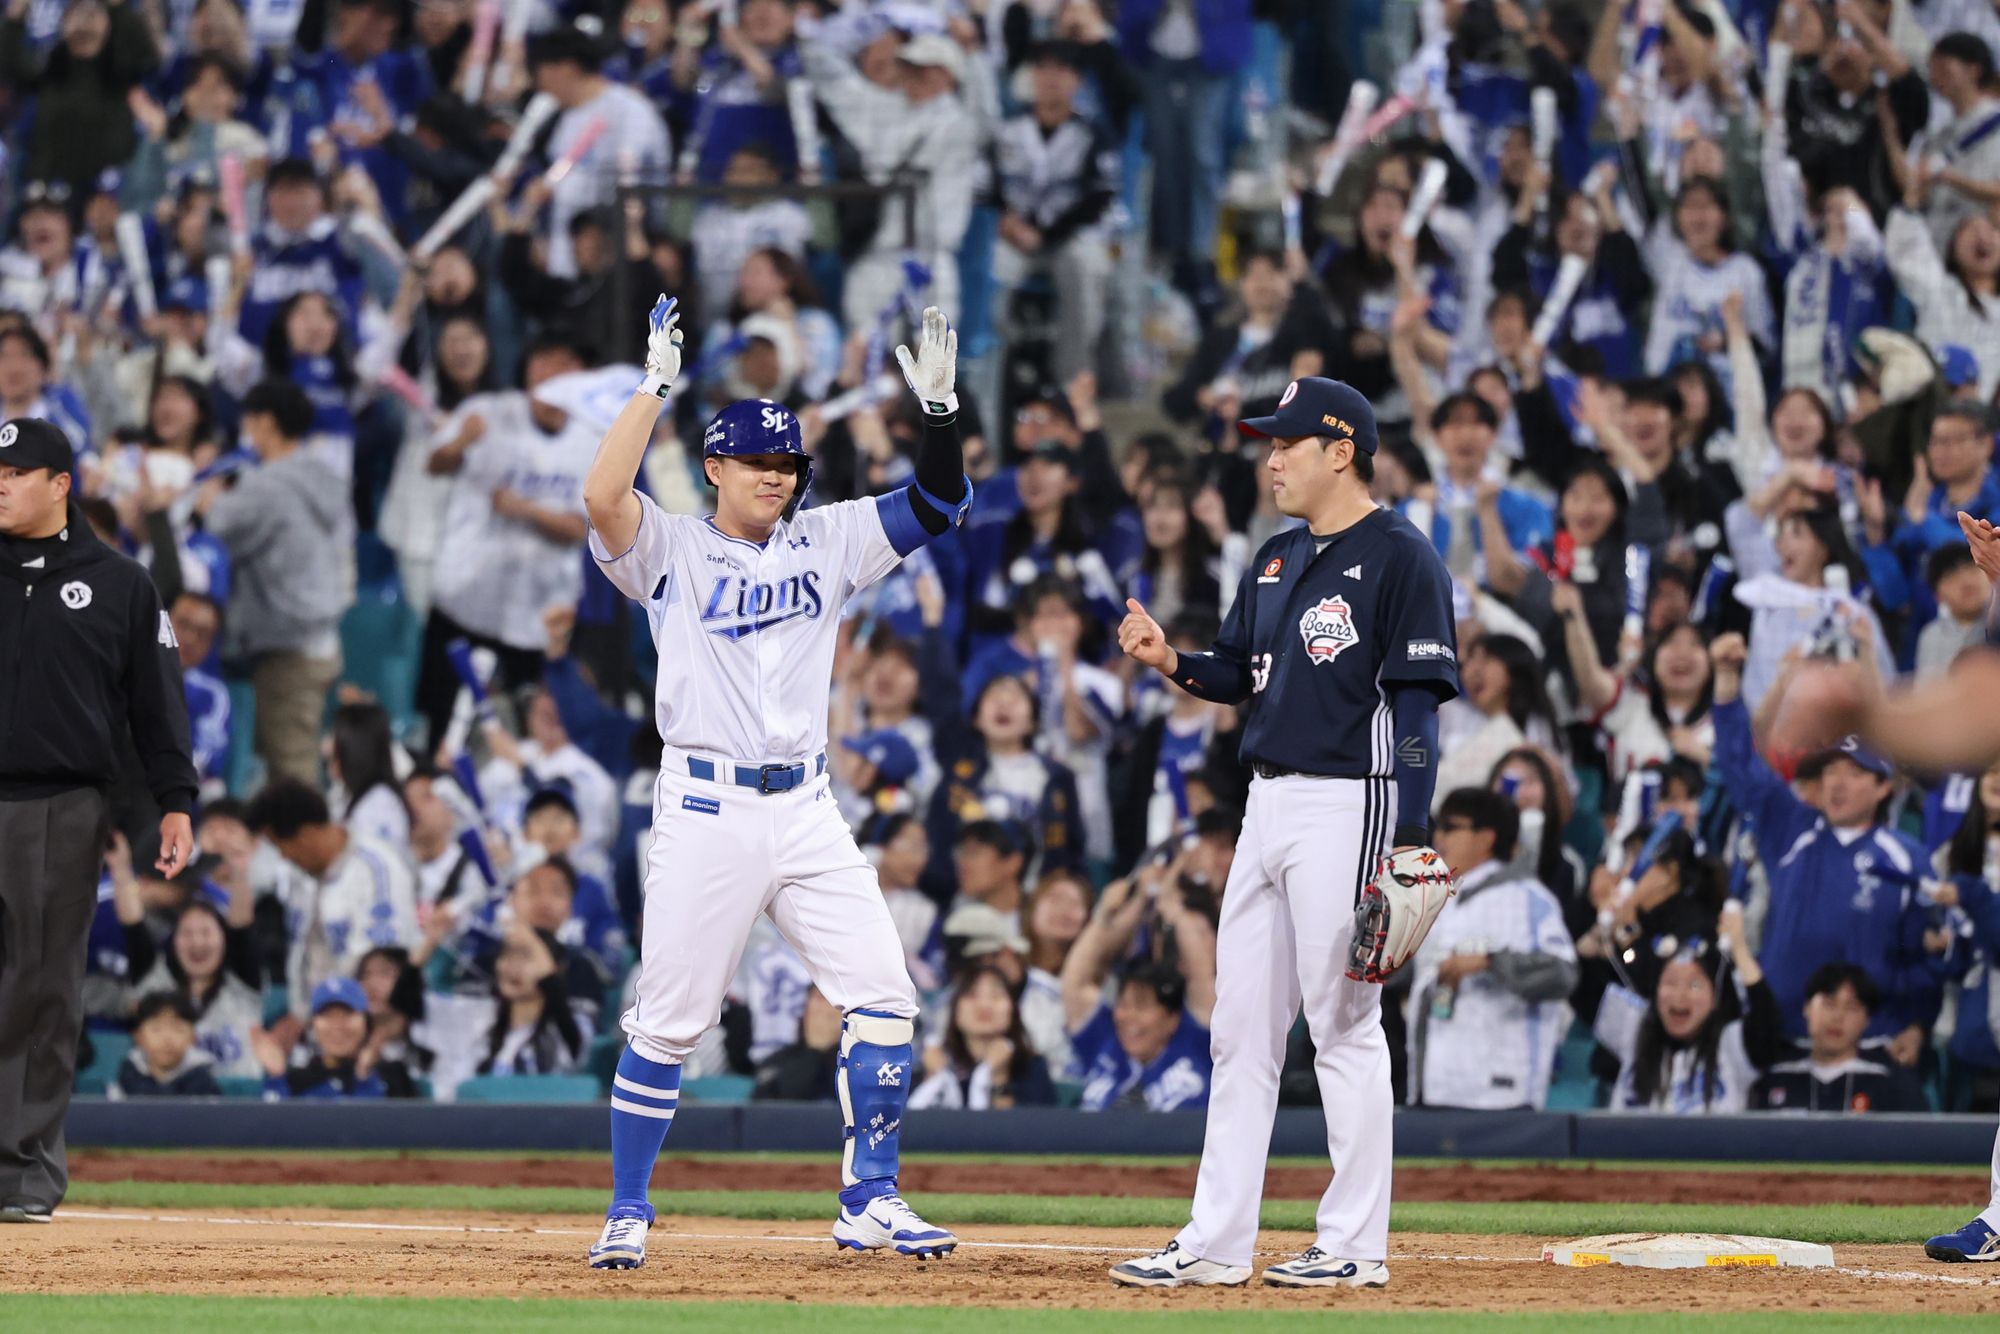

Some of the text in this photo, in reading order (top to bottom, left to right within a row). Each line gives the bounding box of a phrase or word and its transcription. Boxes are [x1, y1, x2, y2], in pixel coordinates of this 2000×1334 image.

[1322, 414, 1355, 436] KB Pay
[700, 570, 823, 621] Lions
[1303, 611, 1352, 637] Bears
[691, 801, 718, 811] monimo
[878, 1078, 901, 1086] NINE
[870, 1112, 884, 1129] 34
